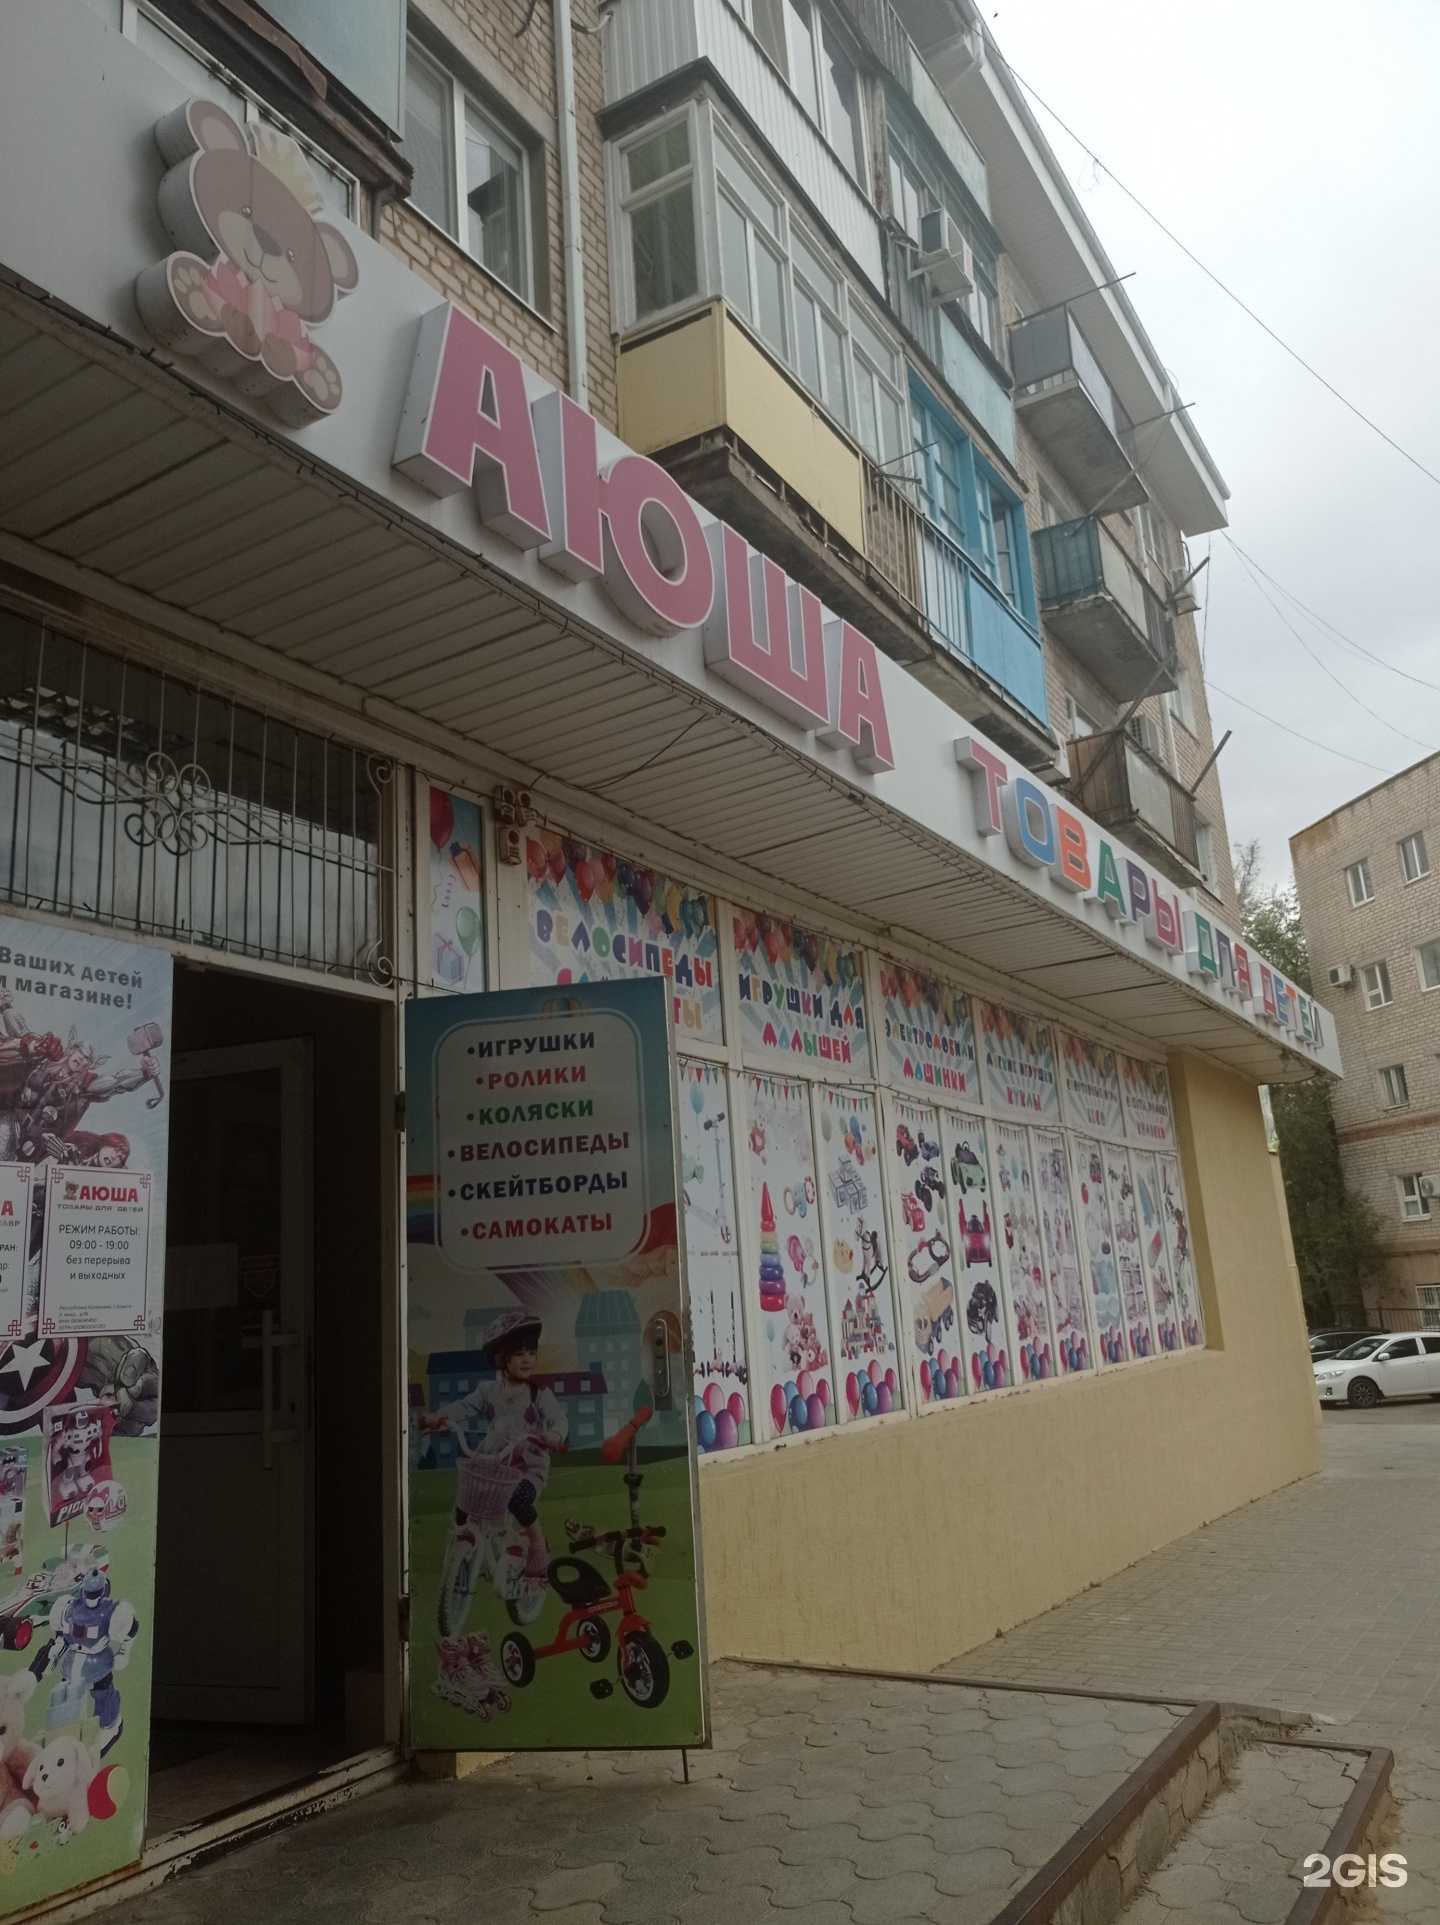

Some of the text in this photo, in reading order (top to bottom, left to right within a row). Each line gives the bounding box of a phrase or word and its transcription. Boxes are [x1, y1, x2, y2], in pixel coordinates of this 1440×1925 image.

[420, 303, 895, 771] АЮША
[969, 736, 1184, 955] ТОВАРЫ
[1194, 911, 1254, 999] ДЛЯ
[536, 909, 713, 988] ВЕЛОСИПЕДЫ
[0, 946, 143, 989] Ваших детей
[15, 977, 132, 1010] магазине!
[738, 973, 823, 1018] ИГРУШКИ
[830, 1000, 864, 1029] ДЛЯ
[478, 1031, 595, 1058] ИГРУШКИ
[762, 1021, 851, 1063] МАЛЫШЕЙ
[488, 1065, 587, 1090] РОЛИКИ
[479, 1099, 594, 1126] КОЛЯСКИ
[459, 1131, 630, 1163] ВЕЛОСИПЕДЫ
[79, 1185, 139, 1203] АЮША
[459, 1171, 628, 1201] СКЕЙТБОРДЫ
[58, 1224, 96, 1235] РЕЖИМ
[471, 1213, 612, 1240] САМОКАТЫ
[69, 1239, 97, 1250] 09:00
[106, 1239, 130, 1251] 19:00
[66, 1254, 131, 1267] без перерыва
[78, 1271, 127, 1281] выходных
